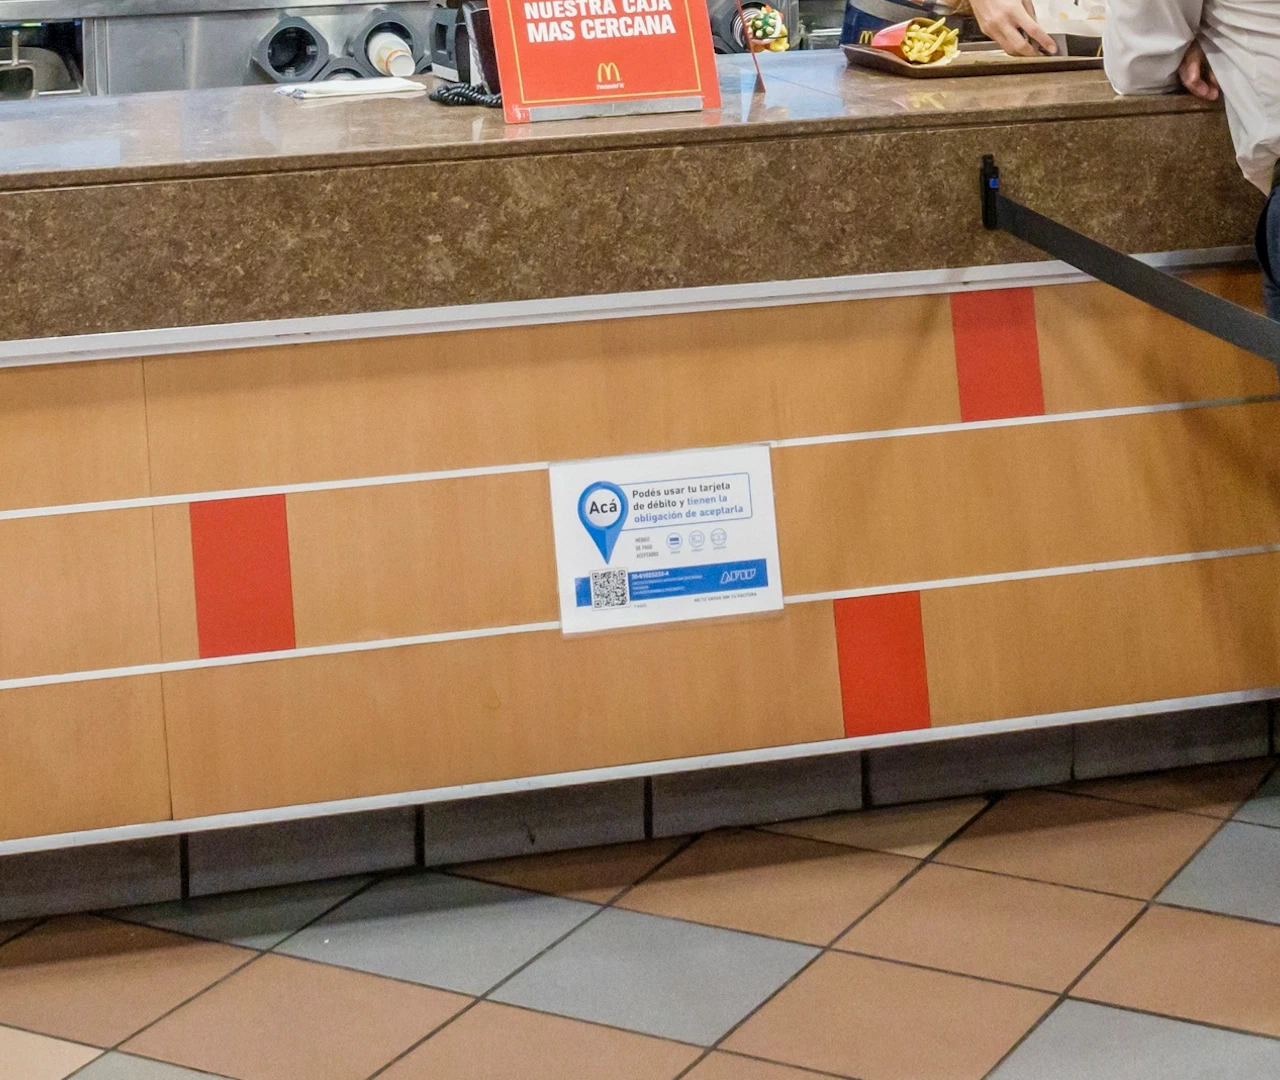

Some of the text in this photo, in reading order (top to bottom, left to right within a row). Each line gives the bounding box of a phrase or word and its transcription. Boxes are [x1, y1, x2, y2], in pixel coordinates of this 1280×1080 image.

[527, 14, 676, 43] MAS CERCANA
[632, 482, 731, 499] Podés usar tu tarjeta
[589, 498, 618, 515] Acá
[633, 494, 727, 511] de débito y tienen la
[634, 505, 744, 524] obligación de aceptarla
